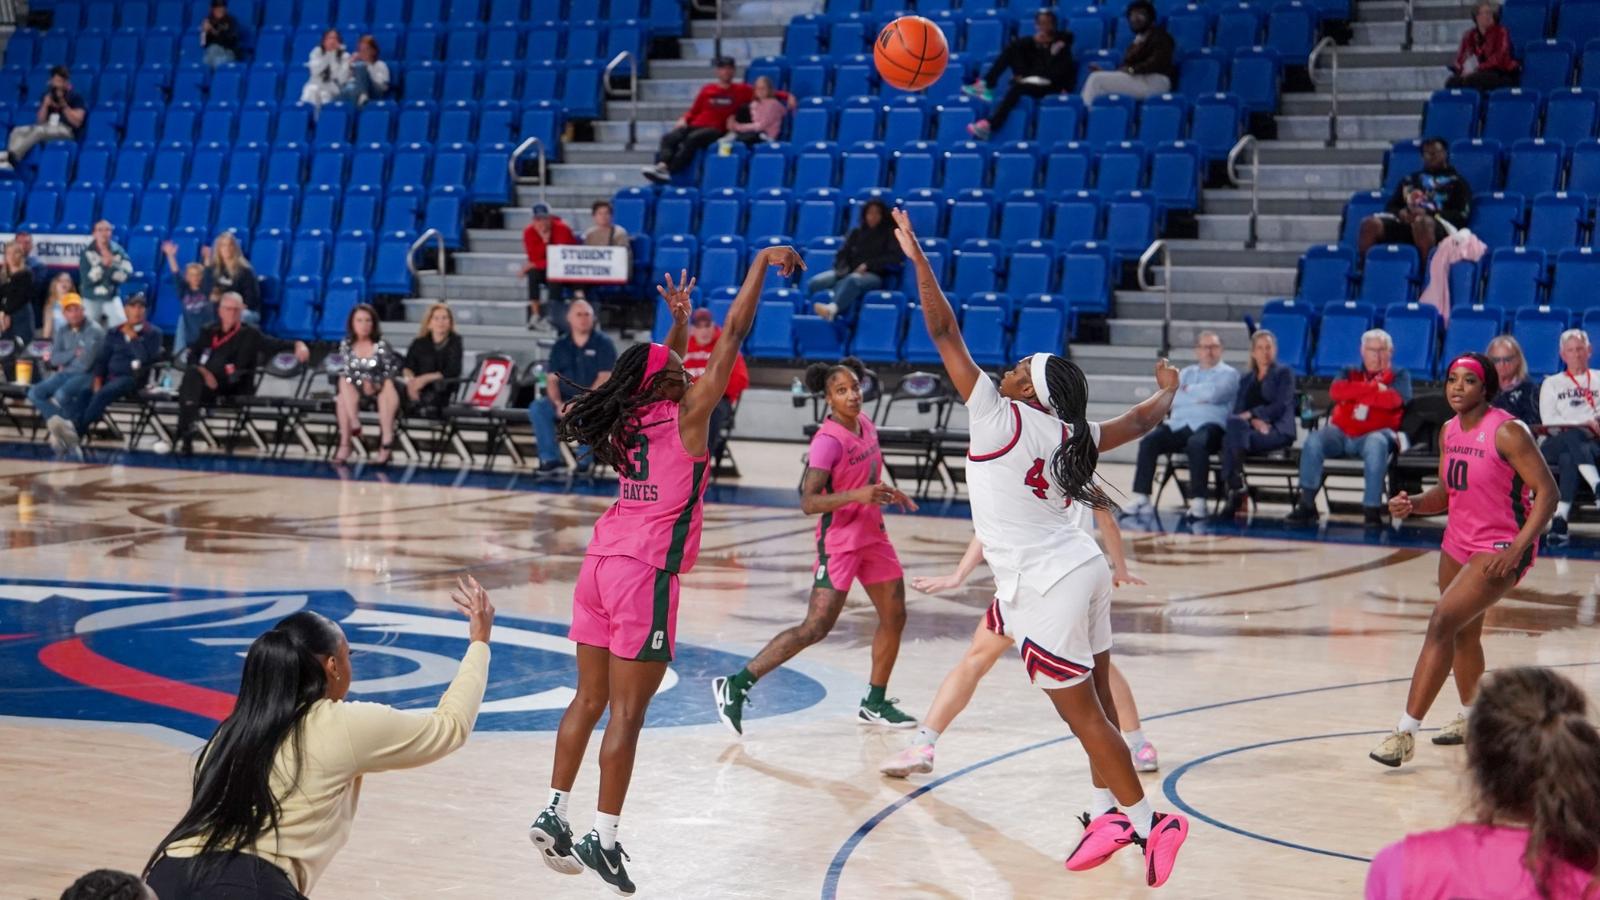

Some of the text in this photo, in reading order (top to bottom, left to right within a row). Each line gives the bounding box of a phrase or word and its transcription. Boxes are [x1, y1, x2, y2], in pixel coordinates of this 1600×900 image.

[561, 248, 613, 261] STUDENT
[564, 264, 611, 276] SECTION
[479, 364, 506, 396] 3
[625, 432, 649, 481] 3
[1446, 457, 1469, 492] 10
[623, 482, 658, 502] HAYES
